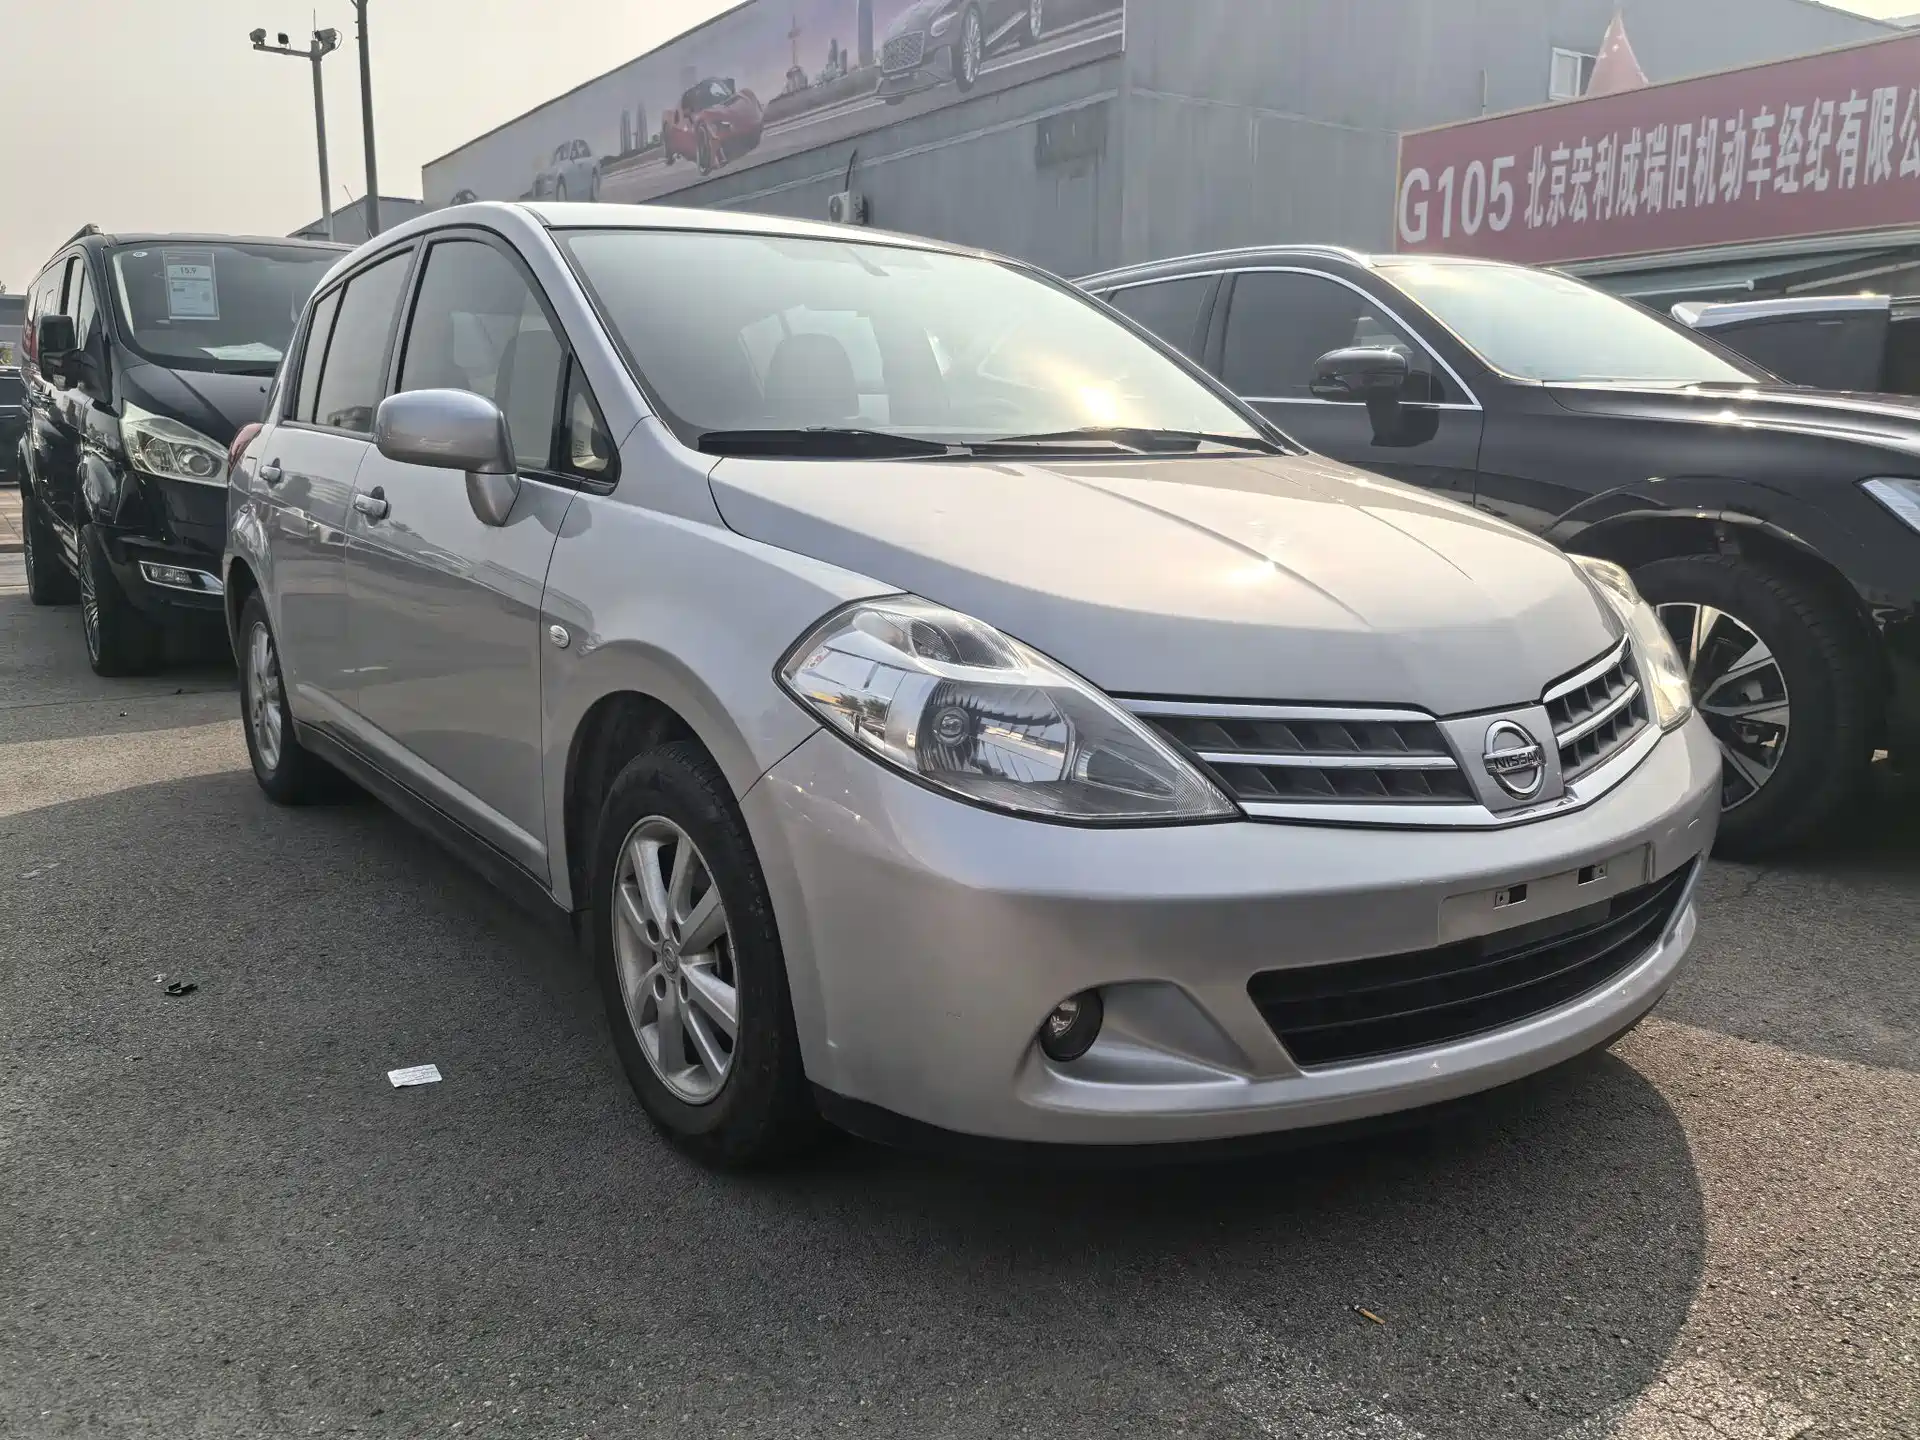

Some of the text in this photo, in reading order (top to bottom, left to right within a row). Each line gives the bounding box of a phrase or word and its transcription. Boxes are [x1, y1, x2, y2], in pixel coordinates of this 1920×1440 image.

[1399, 85, 1920, 243] G105 北京宏利成瑞旧机动车经纪有限公
[1495, 750, 1542, 768] NISSAN
